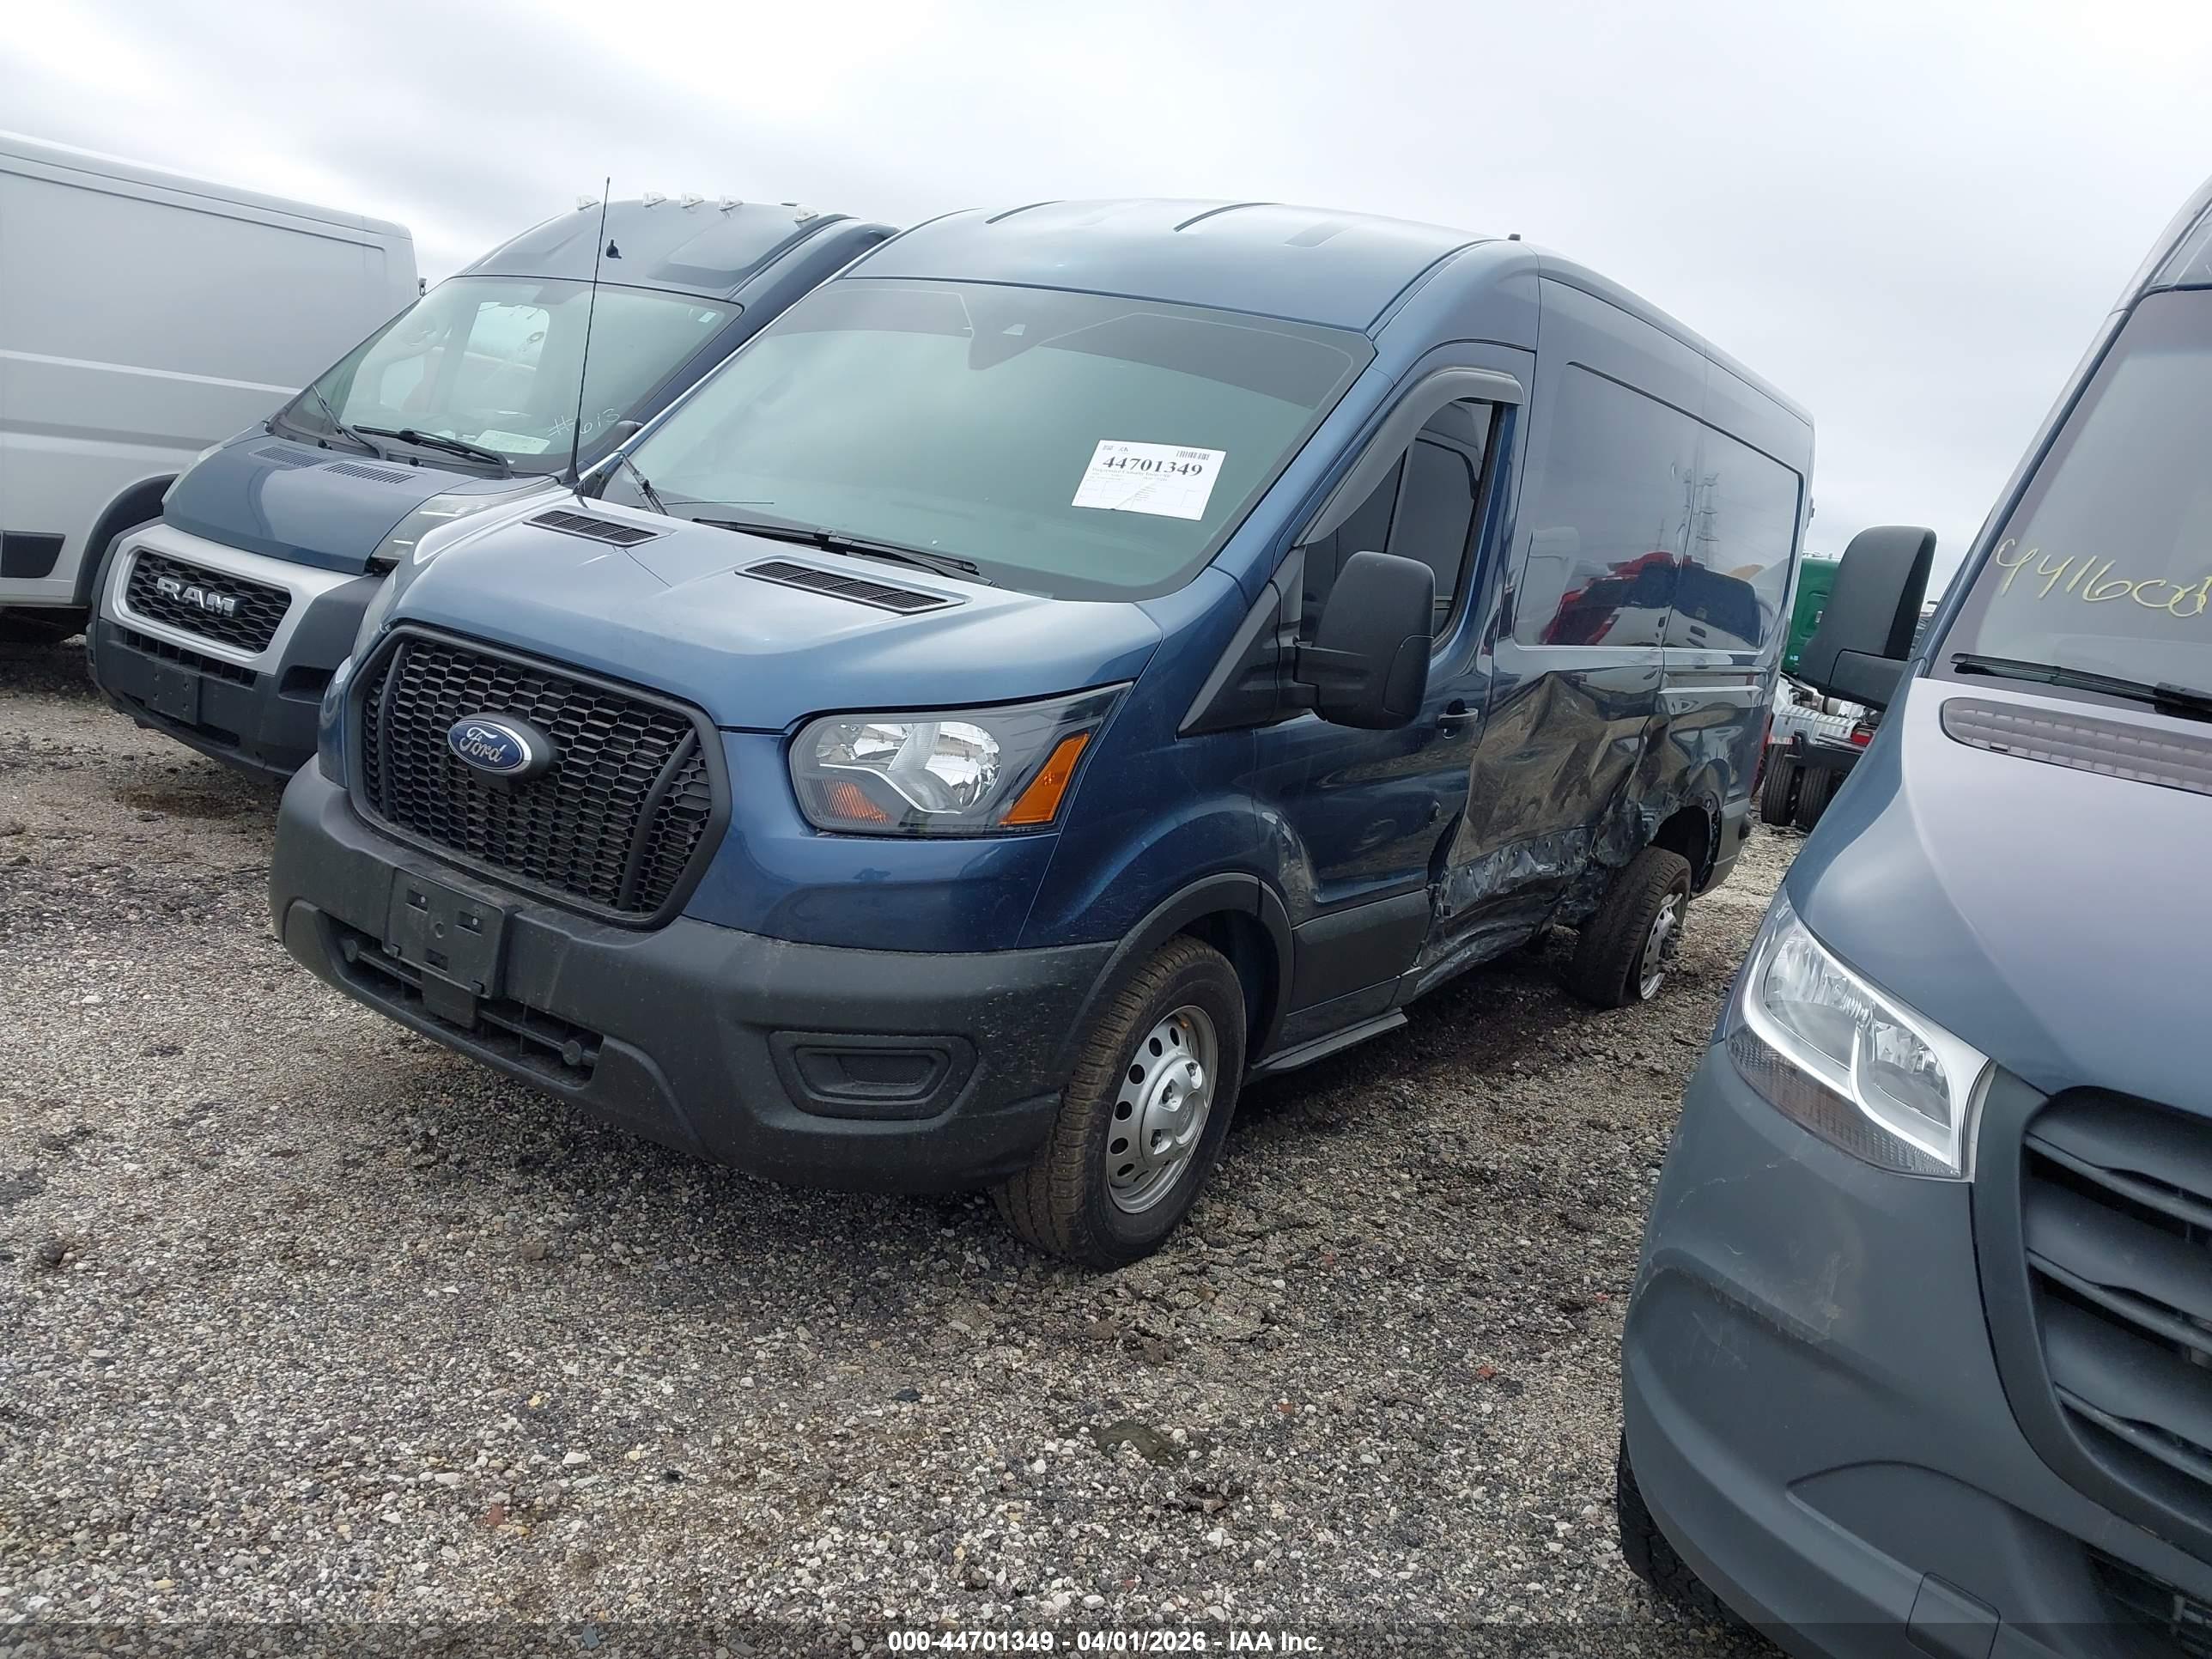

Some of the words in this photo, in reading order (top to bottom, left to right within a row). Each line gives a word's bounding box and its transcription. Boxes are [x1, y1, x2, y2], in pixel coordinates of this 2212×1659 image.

[1103, 456, 1203, 477] 44701349
[156, 576, 238, 618] RAM
[459, 726, 507, 763] Ford
